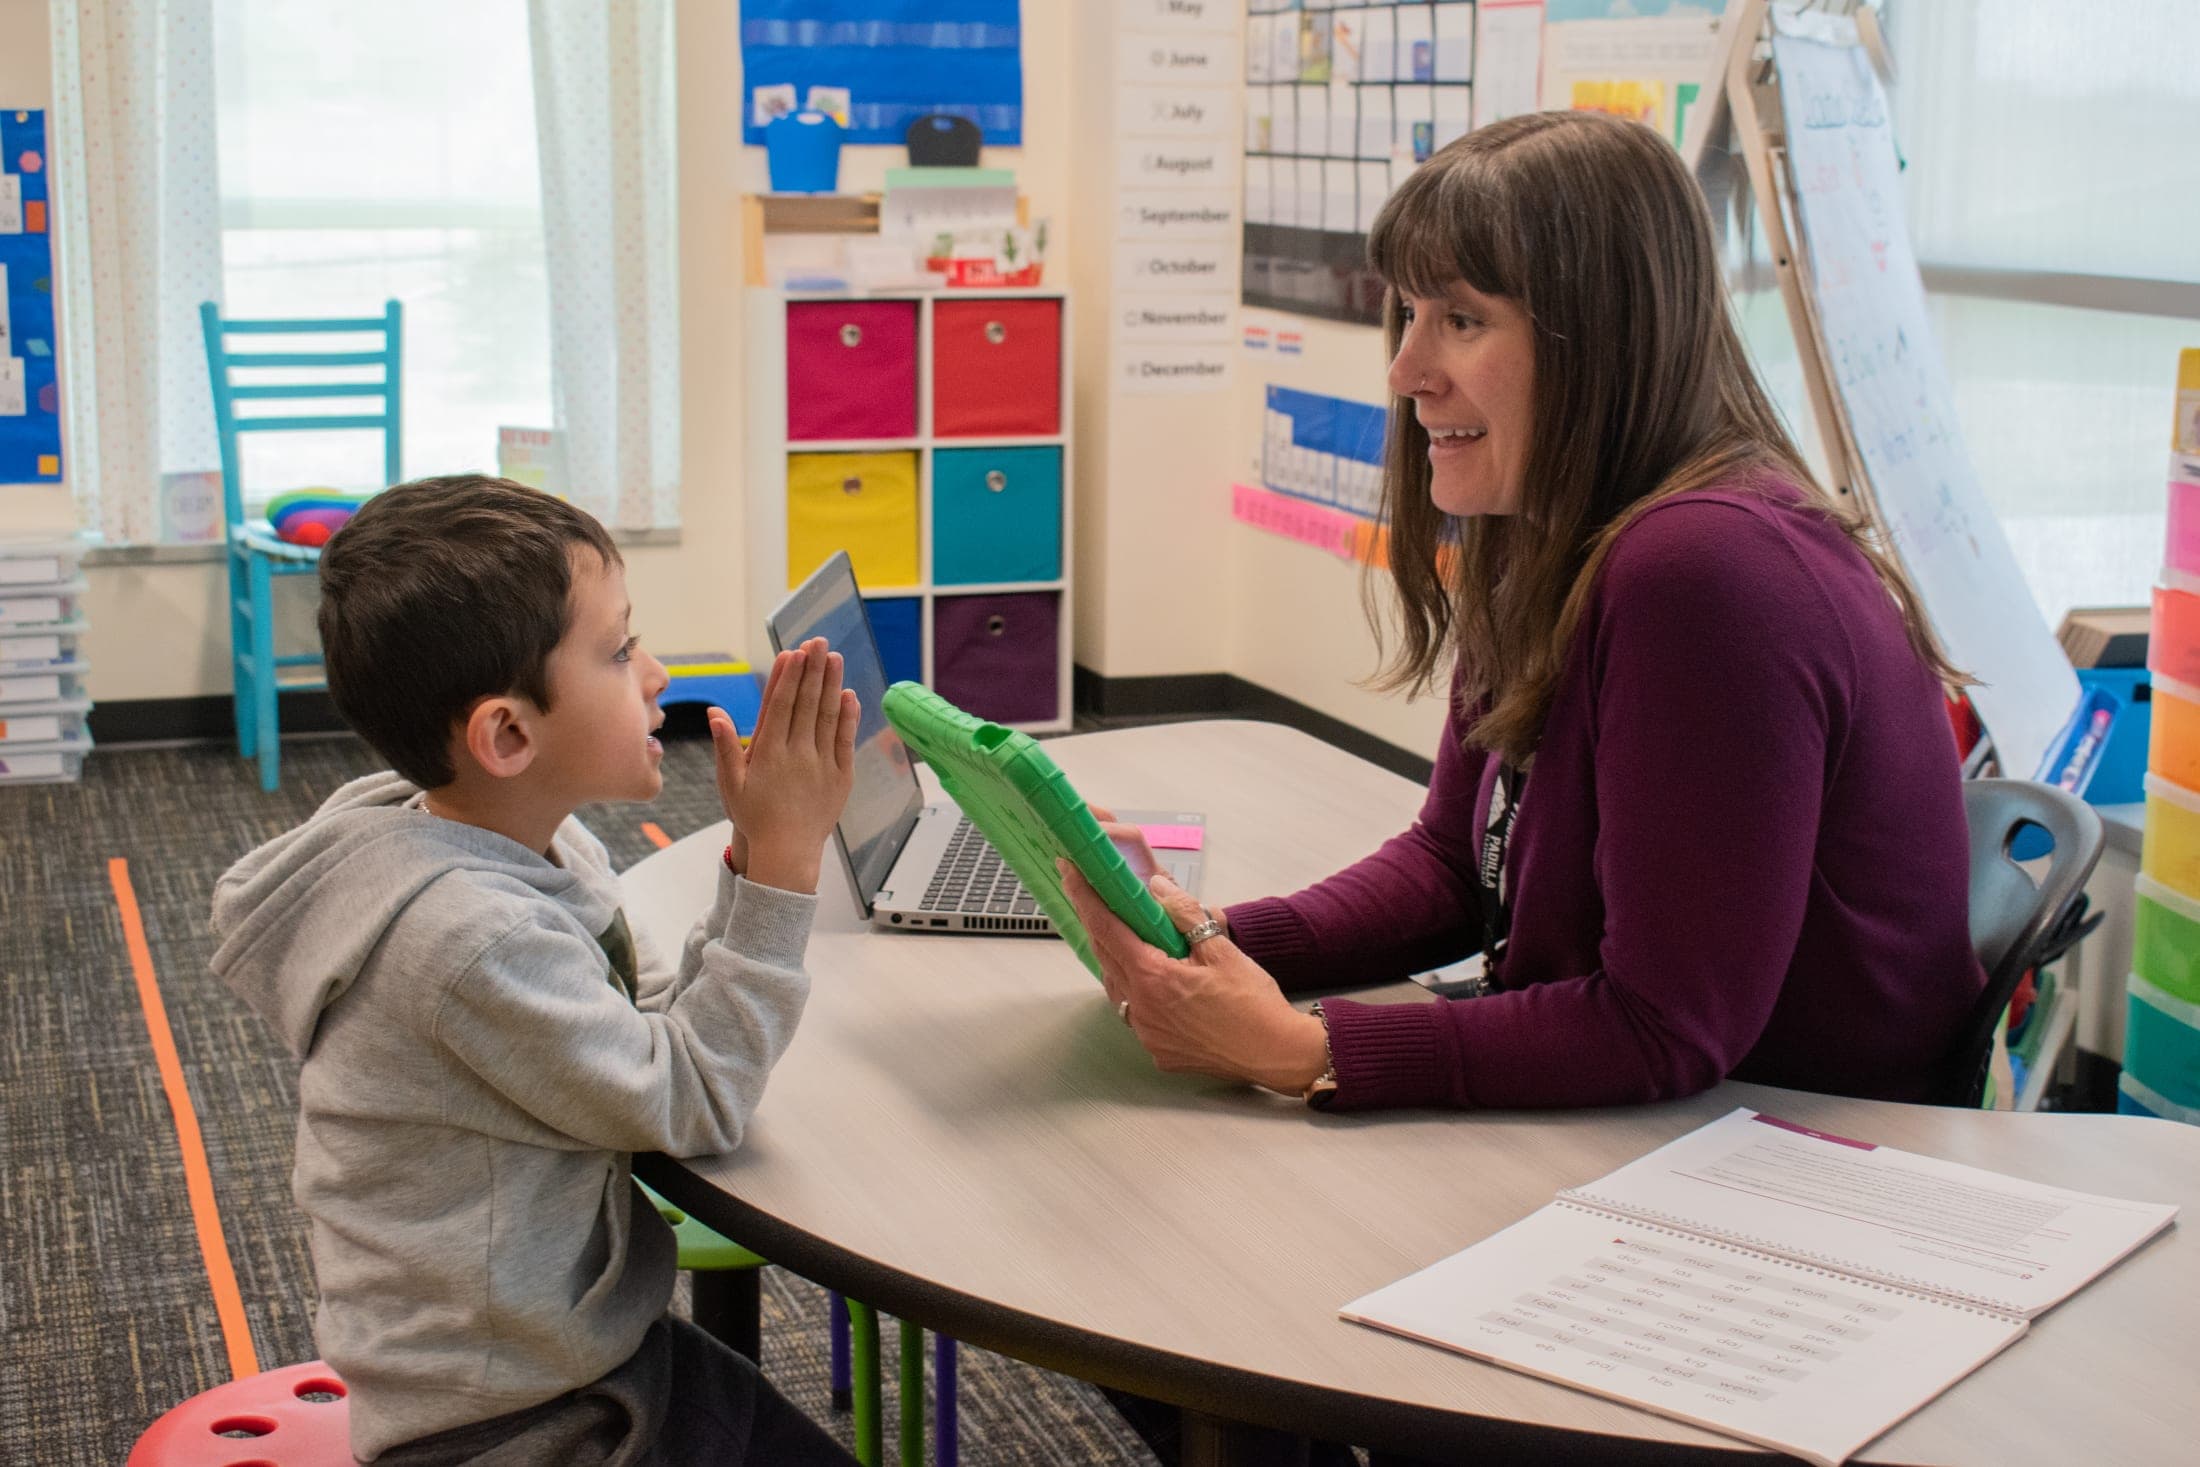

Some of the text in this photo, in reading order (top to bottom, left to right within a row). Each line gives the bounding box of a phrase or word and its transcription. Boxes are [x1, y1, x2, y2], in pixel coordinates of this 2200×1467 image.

[1168, 0, 1204, 20] May
[1169, 51, 1208, 66] June
[1170, 103, 1206, 125] July
[1154, 155, 1213, 175] August
[1139, 206, 1230, 228] September
[1148, 258, 1217, 275] October
[1140, 310, 1227, 327] November
[1140, 360, 1225, 377] December
[1487, 834, 1502, 889] PADILLA
[1683, 1258, 1716, 1270] muz
